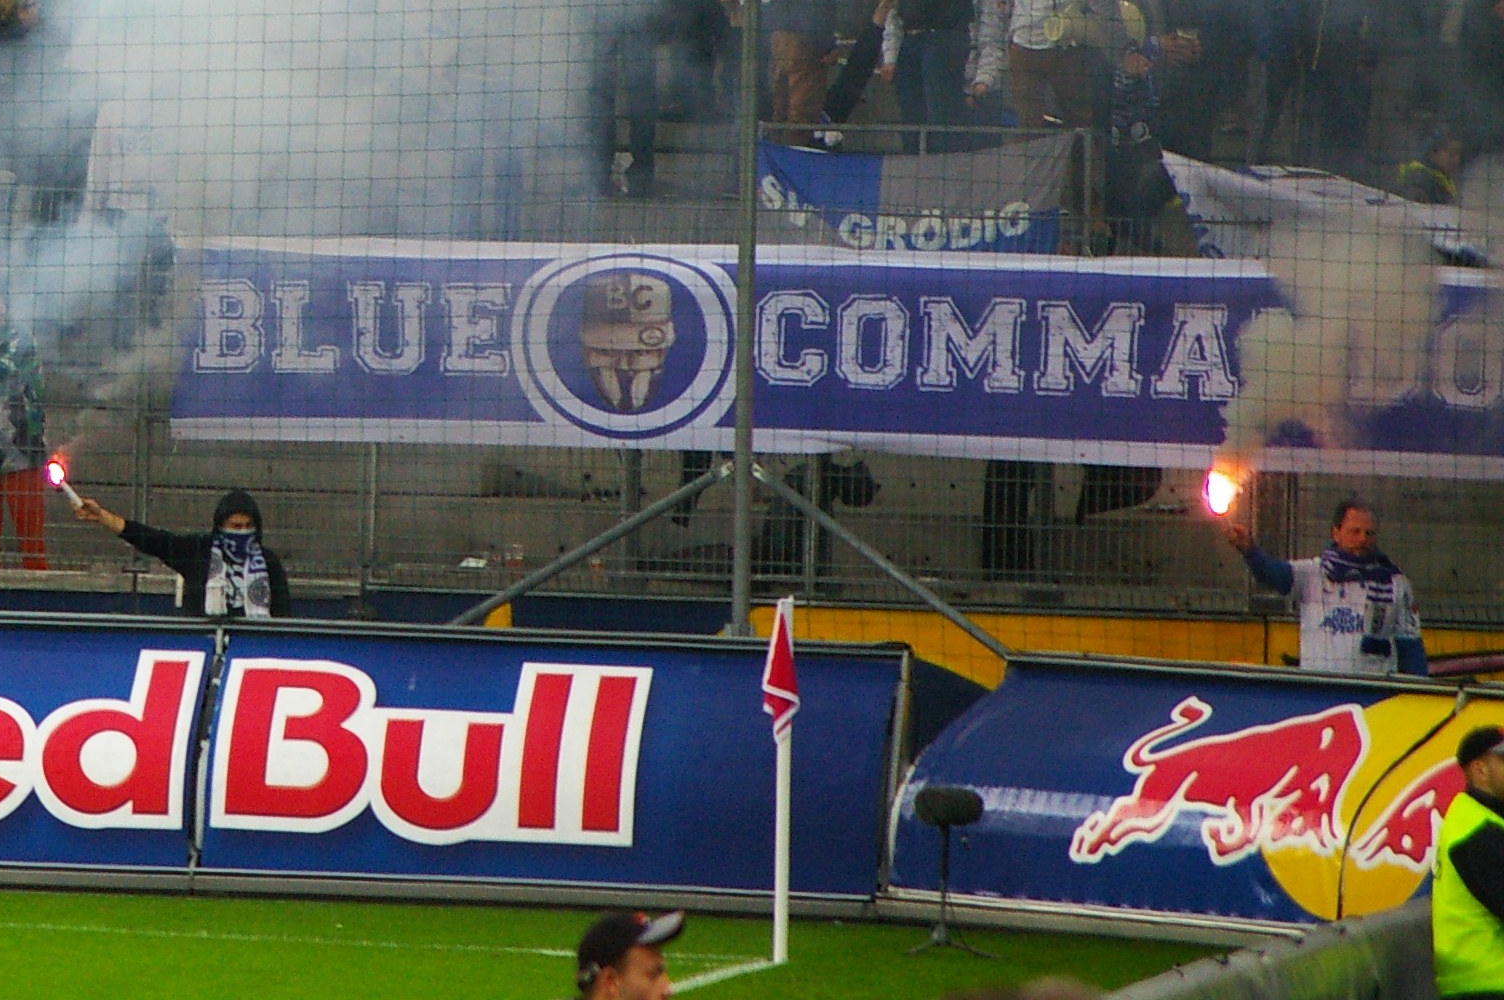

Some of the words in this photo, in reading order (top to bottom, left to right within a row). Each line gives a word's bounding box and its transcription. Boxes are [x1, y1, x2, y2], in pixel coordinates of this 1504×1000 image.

[838, 201, 1031, 251] GRÖDIG
[192, 278, 514, 377] BLUE
[606, 284, 654, 311] BC
[754, 288, 1504, 410] COMMADO
[212, 660, 651, 844] Bull
